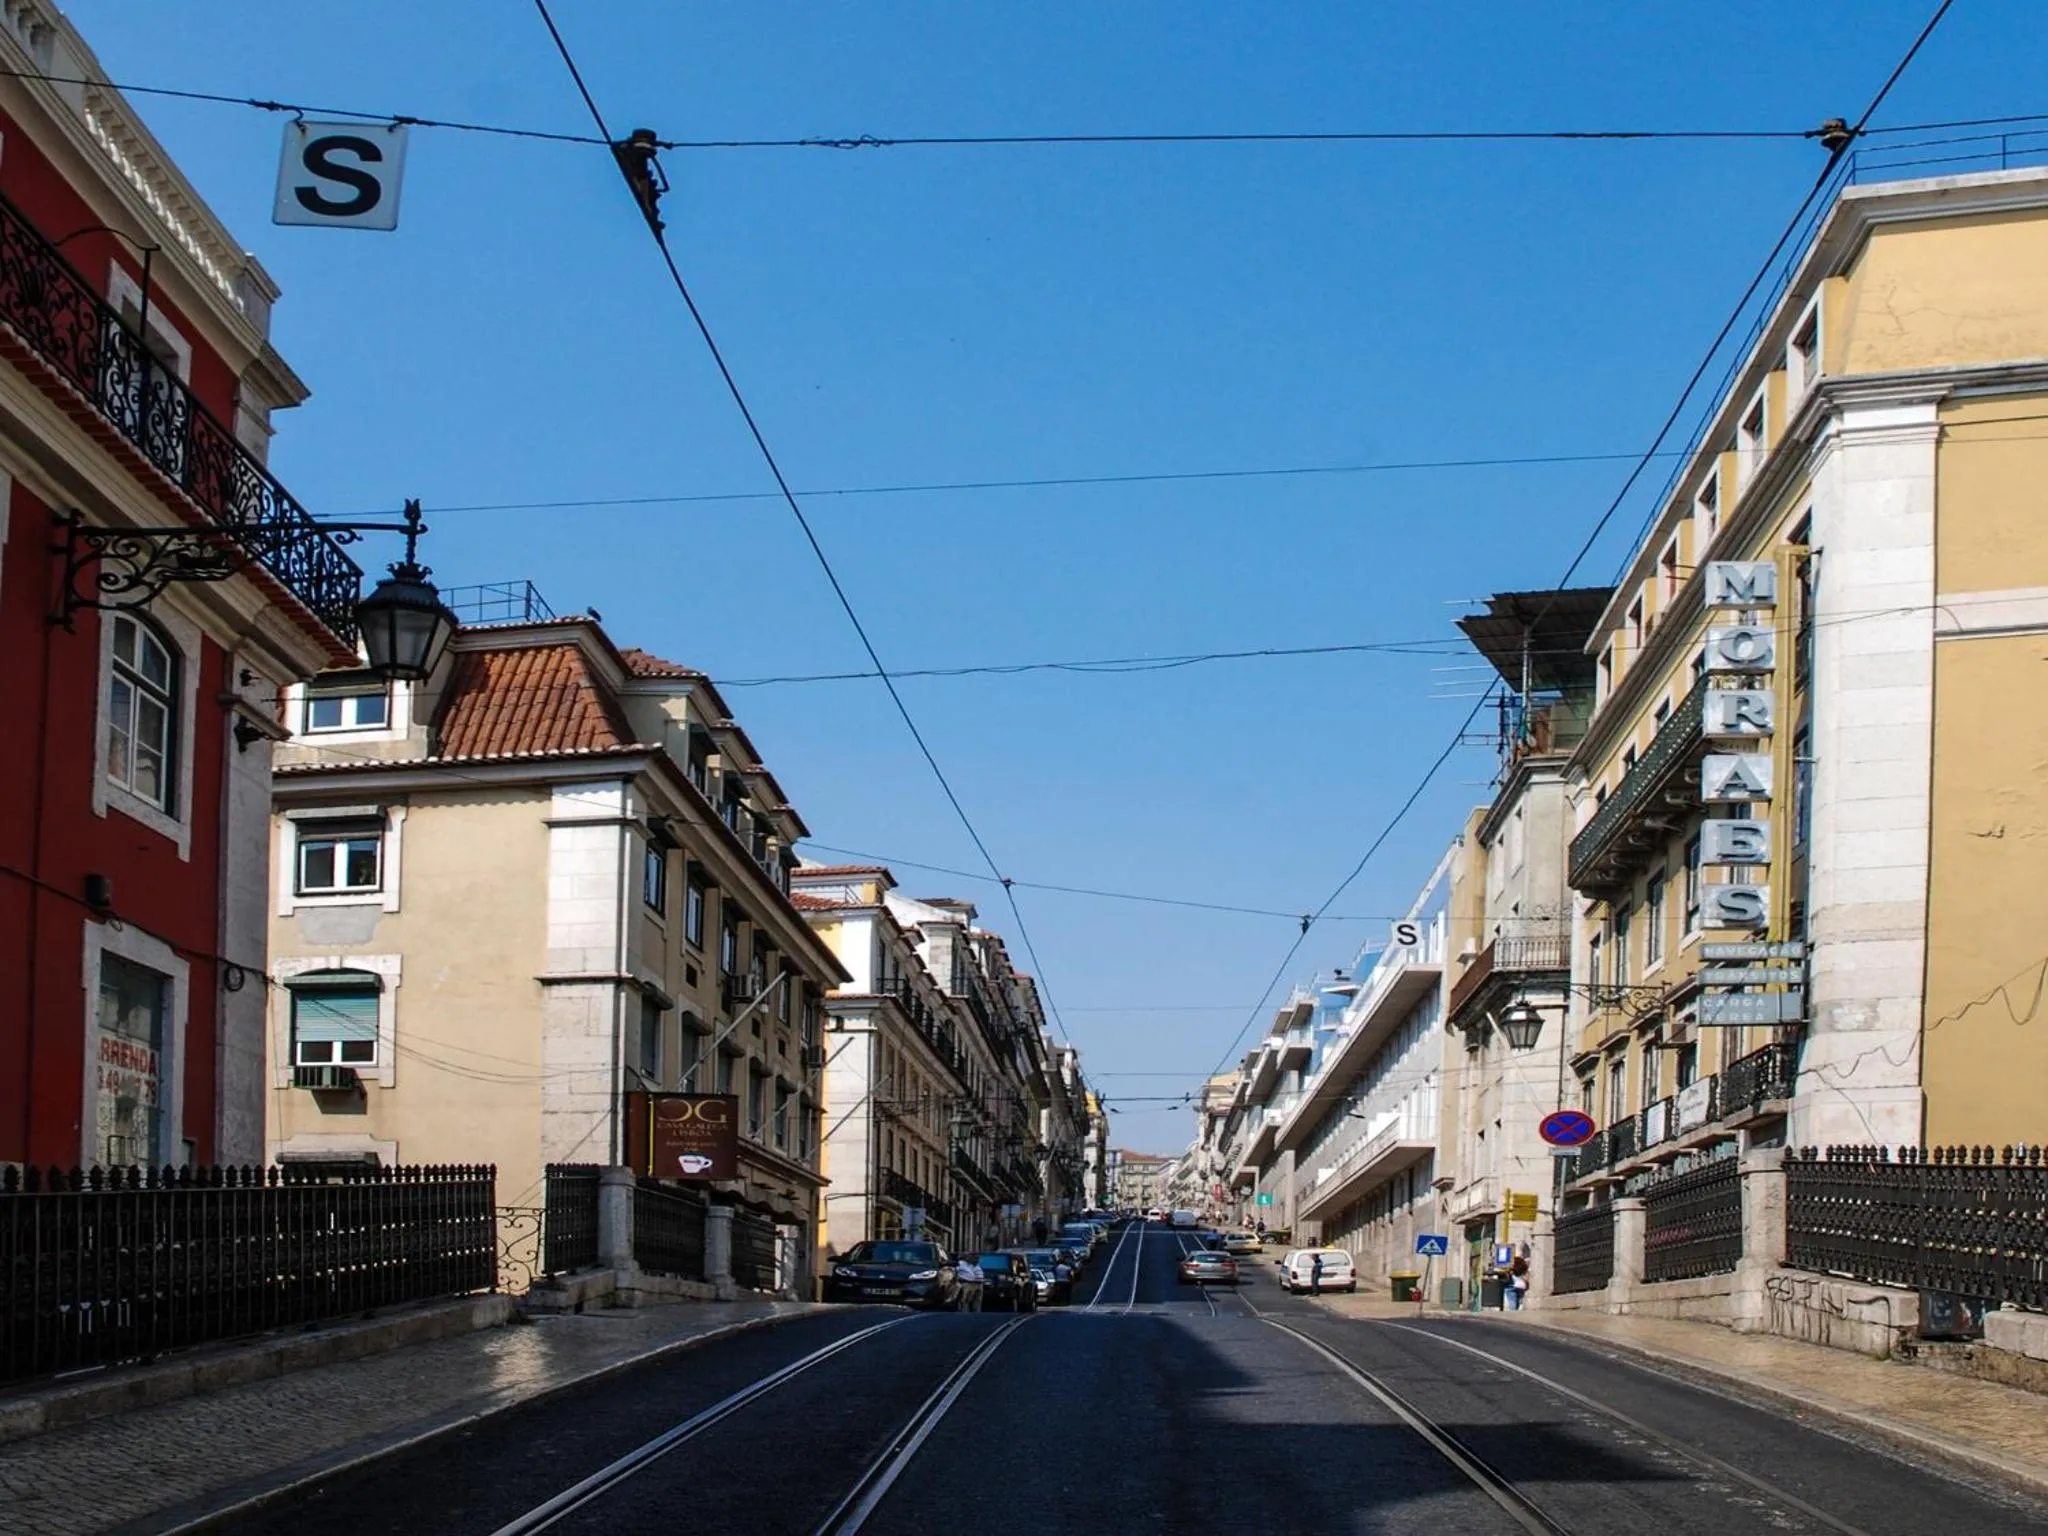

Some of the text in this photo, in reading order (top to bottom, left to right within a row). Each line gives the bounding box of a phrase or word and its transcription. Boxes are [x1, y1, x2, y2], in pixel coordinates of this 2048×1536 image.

[295, 135, 383, 217] S
[1714, 564, 1775, 924] MORAES
[1397, 924, 1418, 945] S
[98, 1037, 157, 1078] RRENDA
